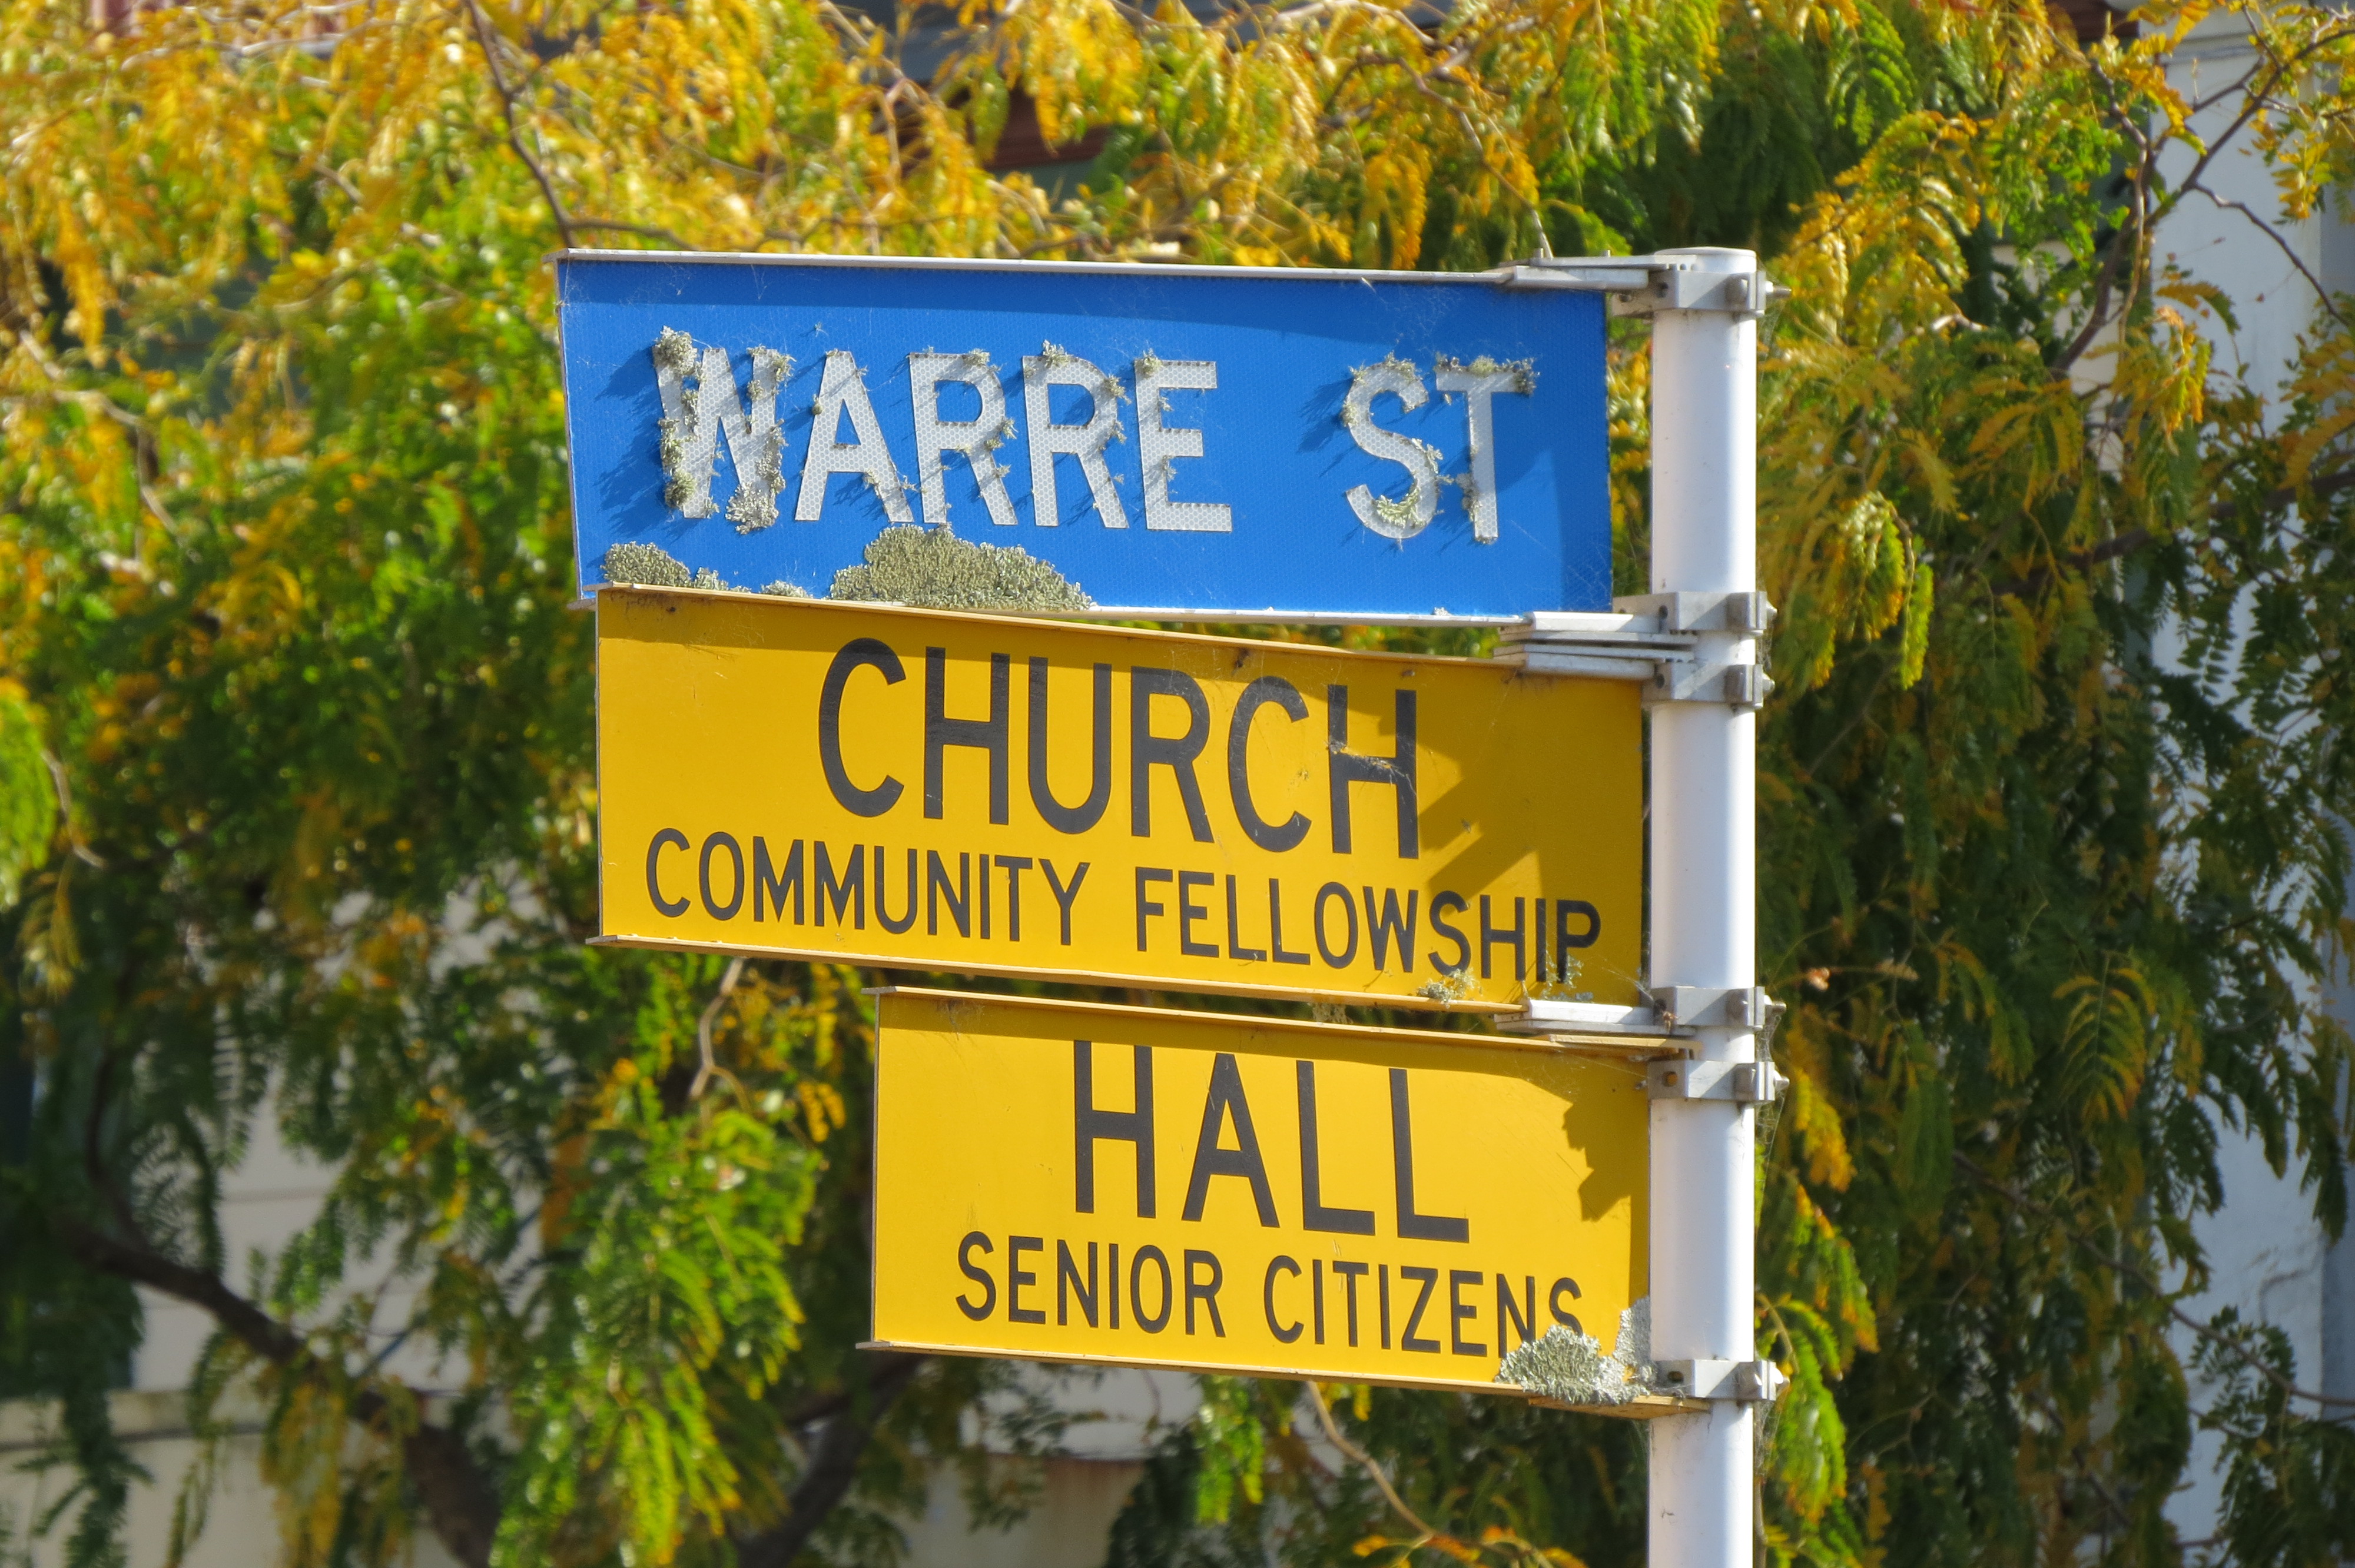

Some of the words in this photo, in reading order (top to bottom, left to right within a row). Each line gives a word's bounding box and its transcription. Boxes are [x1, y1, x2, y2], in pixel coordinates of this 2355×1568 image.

[654, 337, 1232, 533] WARRE
[1341, 360, 1534, 544] ST
[818, 637, 1419, 859] CHURCH
[645, 827, 1090, 947] COMMUNITY
[1133, 867, 1602, 986] FELLOWSHIP
[1073, 1039, 1470, 1244] HALL
[955, 1230, 1227, 1338] SENIOR
[1263, 1254, 1584, 1360] CITIZENS
